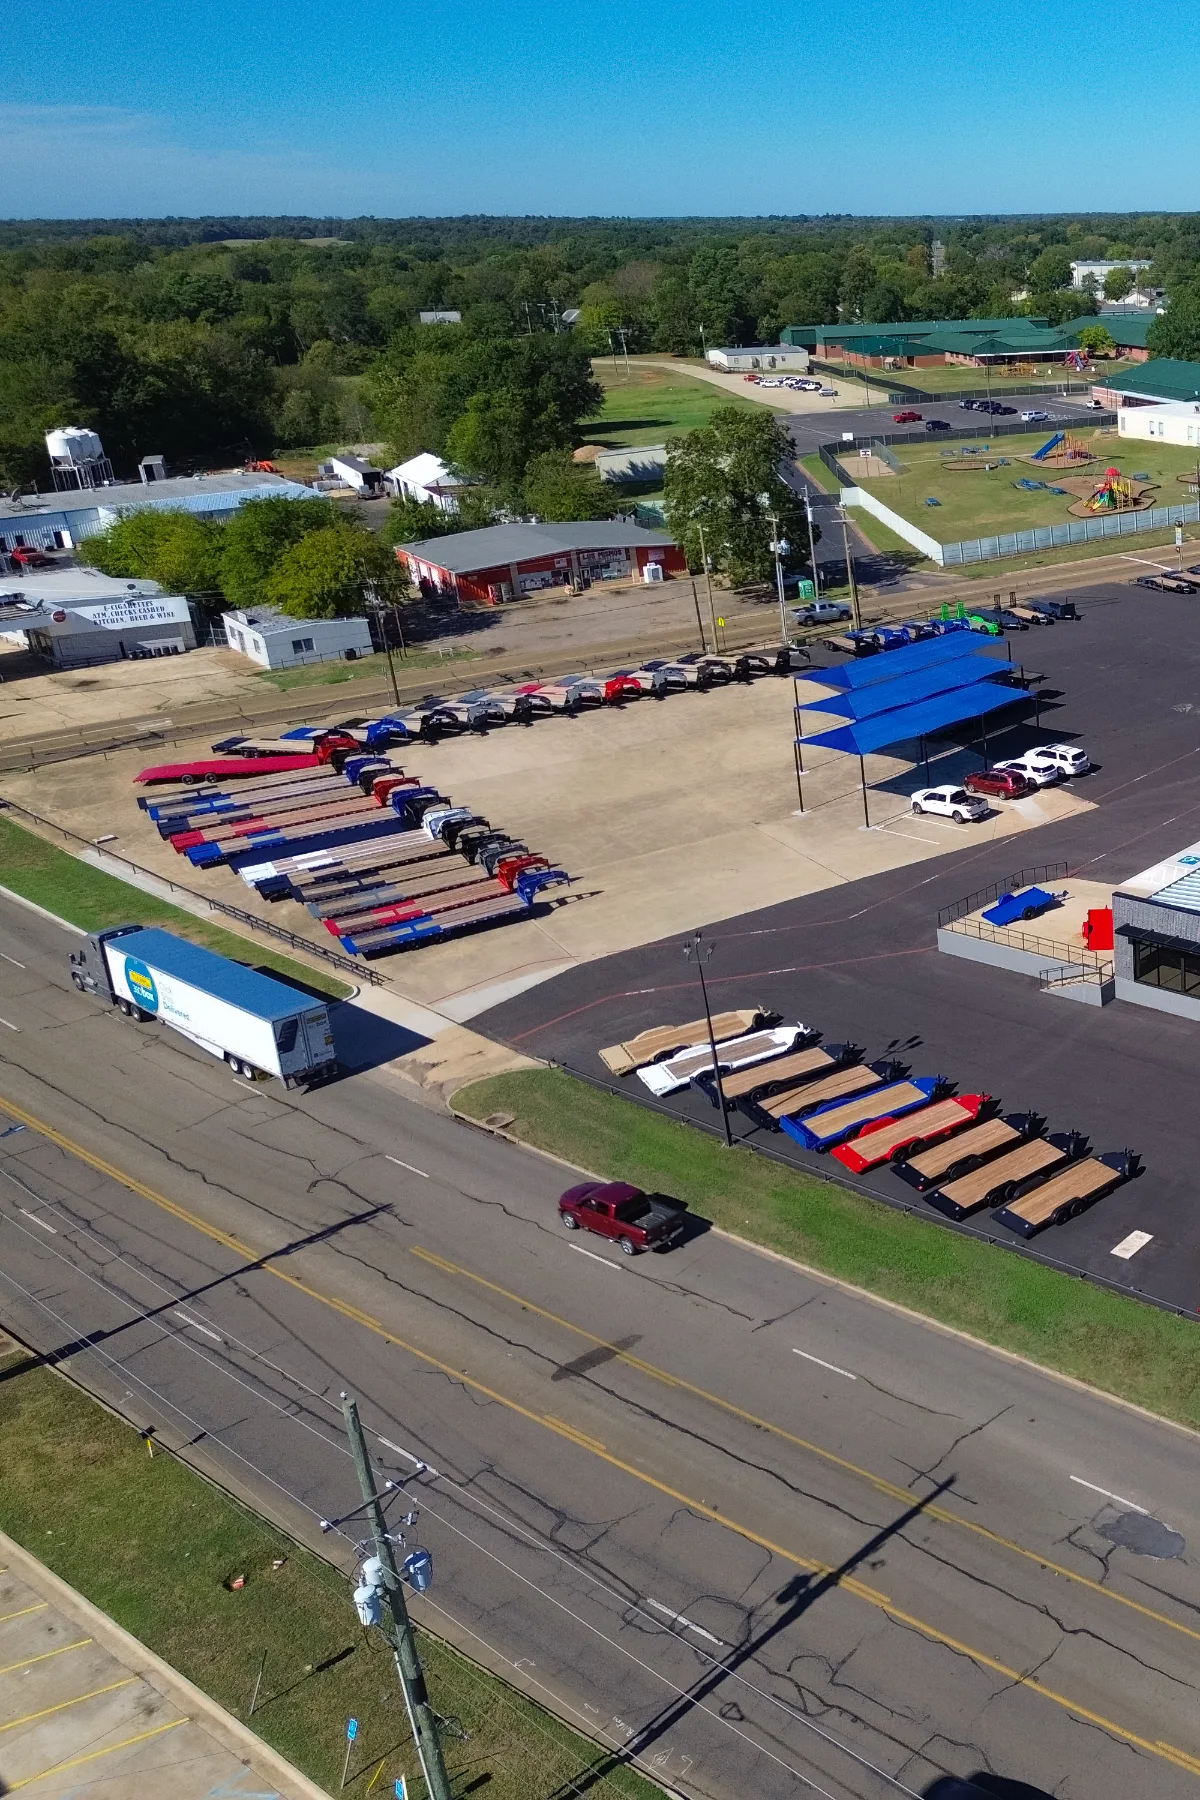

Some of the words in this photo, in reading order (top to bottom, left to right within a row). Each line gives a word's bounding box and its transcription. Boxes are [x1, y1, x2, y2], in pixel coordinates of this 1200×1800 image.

[110, 608, 137, 617] CHECKS
[138, 605, 165, 614] CASHED
[129, 613, 148, 622] BEER
[156, 611, 175, 619] WINE
